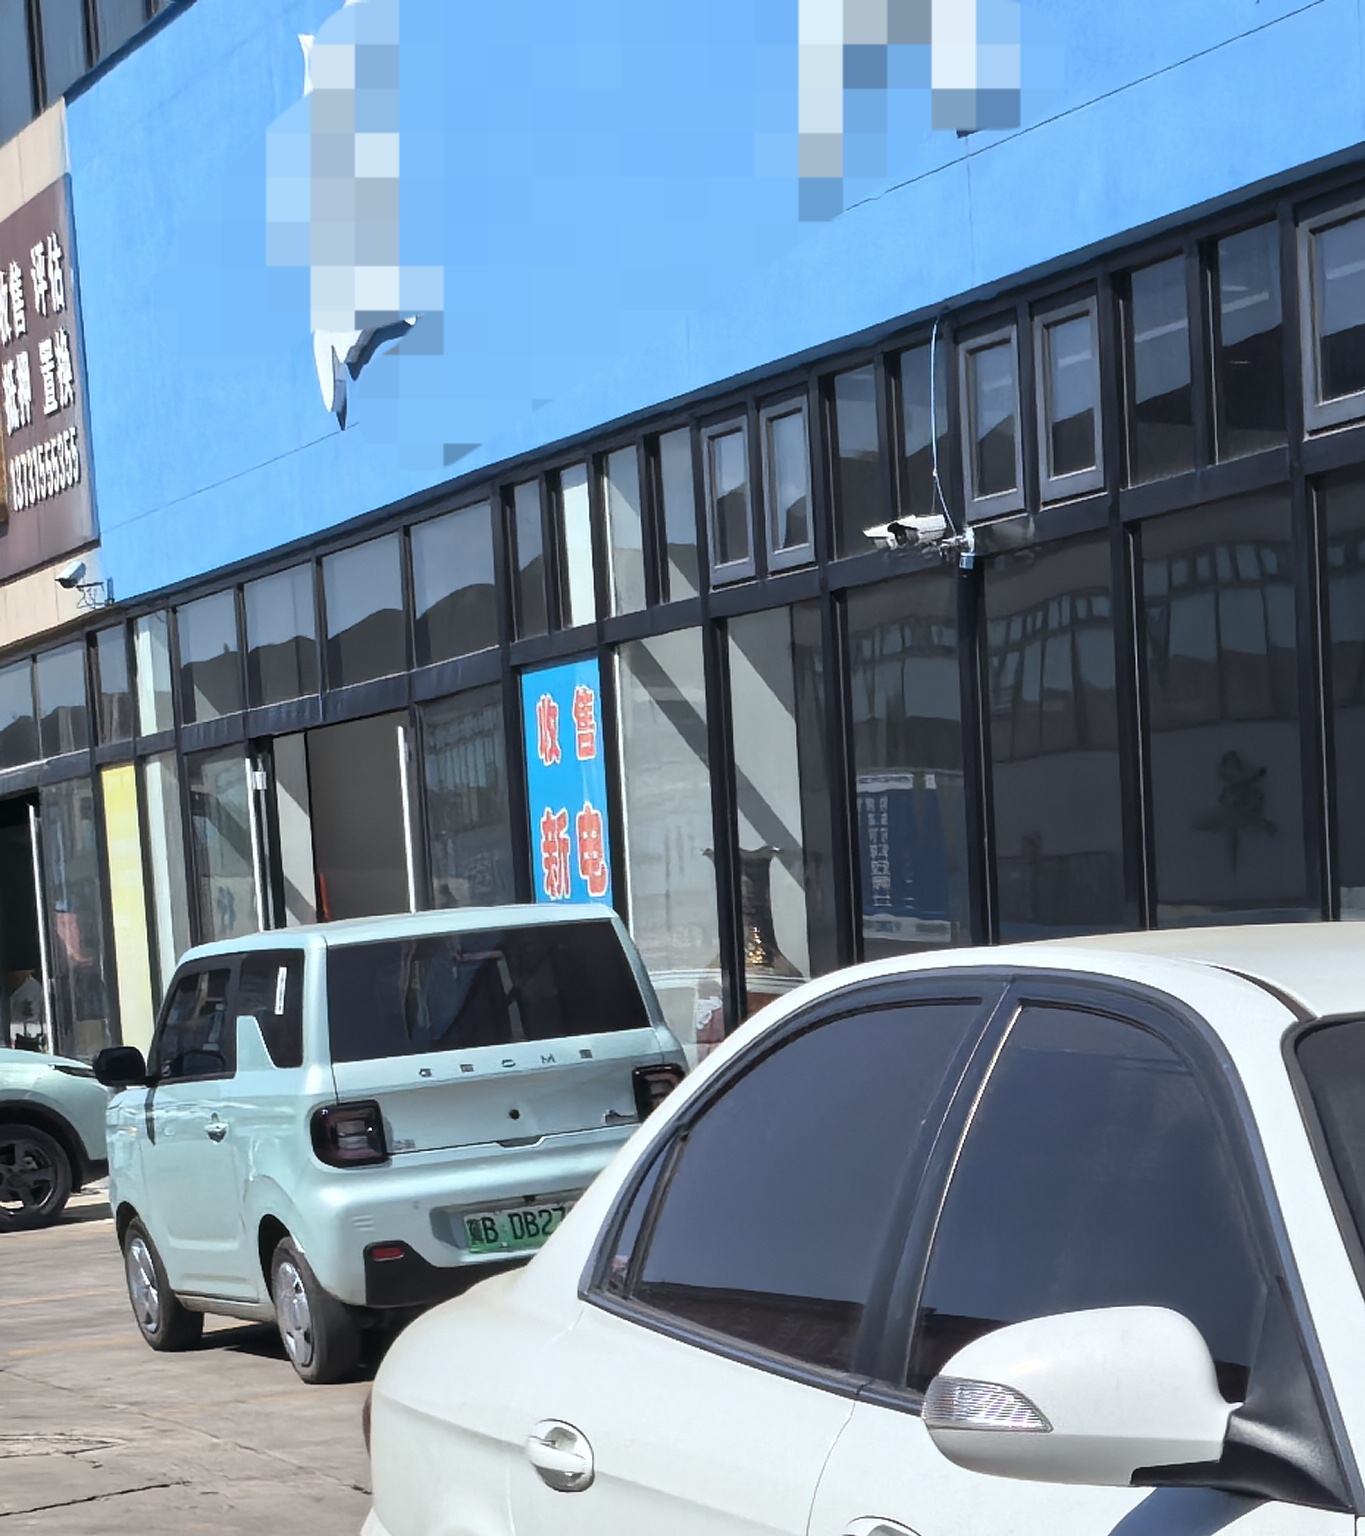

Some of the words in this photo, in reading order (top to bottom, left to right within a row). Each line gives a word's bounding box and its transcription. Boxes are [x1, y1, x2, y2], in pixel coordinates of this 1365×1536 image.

[30, 231, 66, 318] 评估
[38, 326, 75, 416] 置换
[536, 684, 597, 767] 收售
